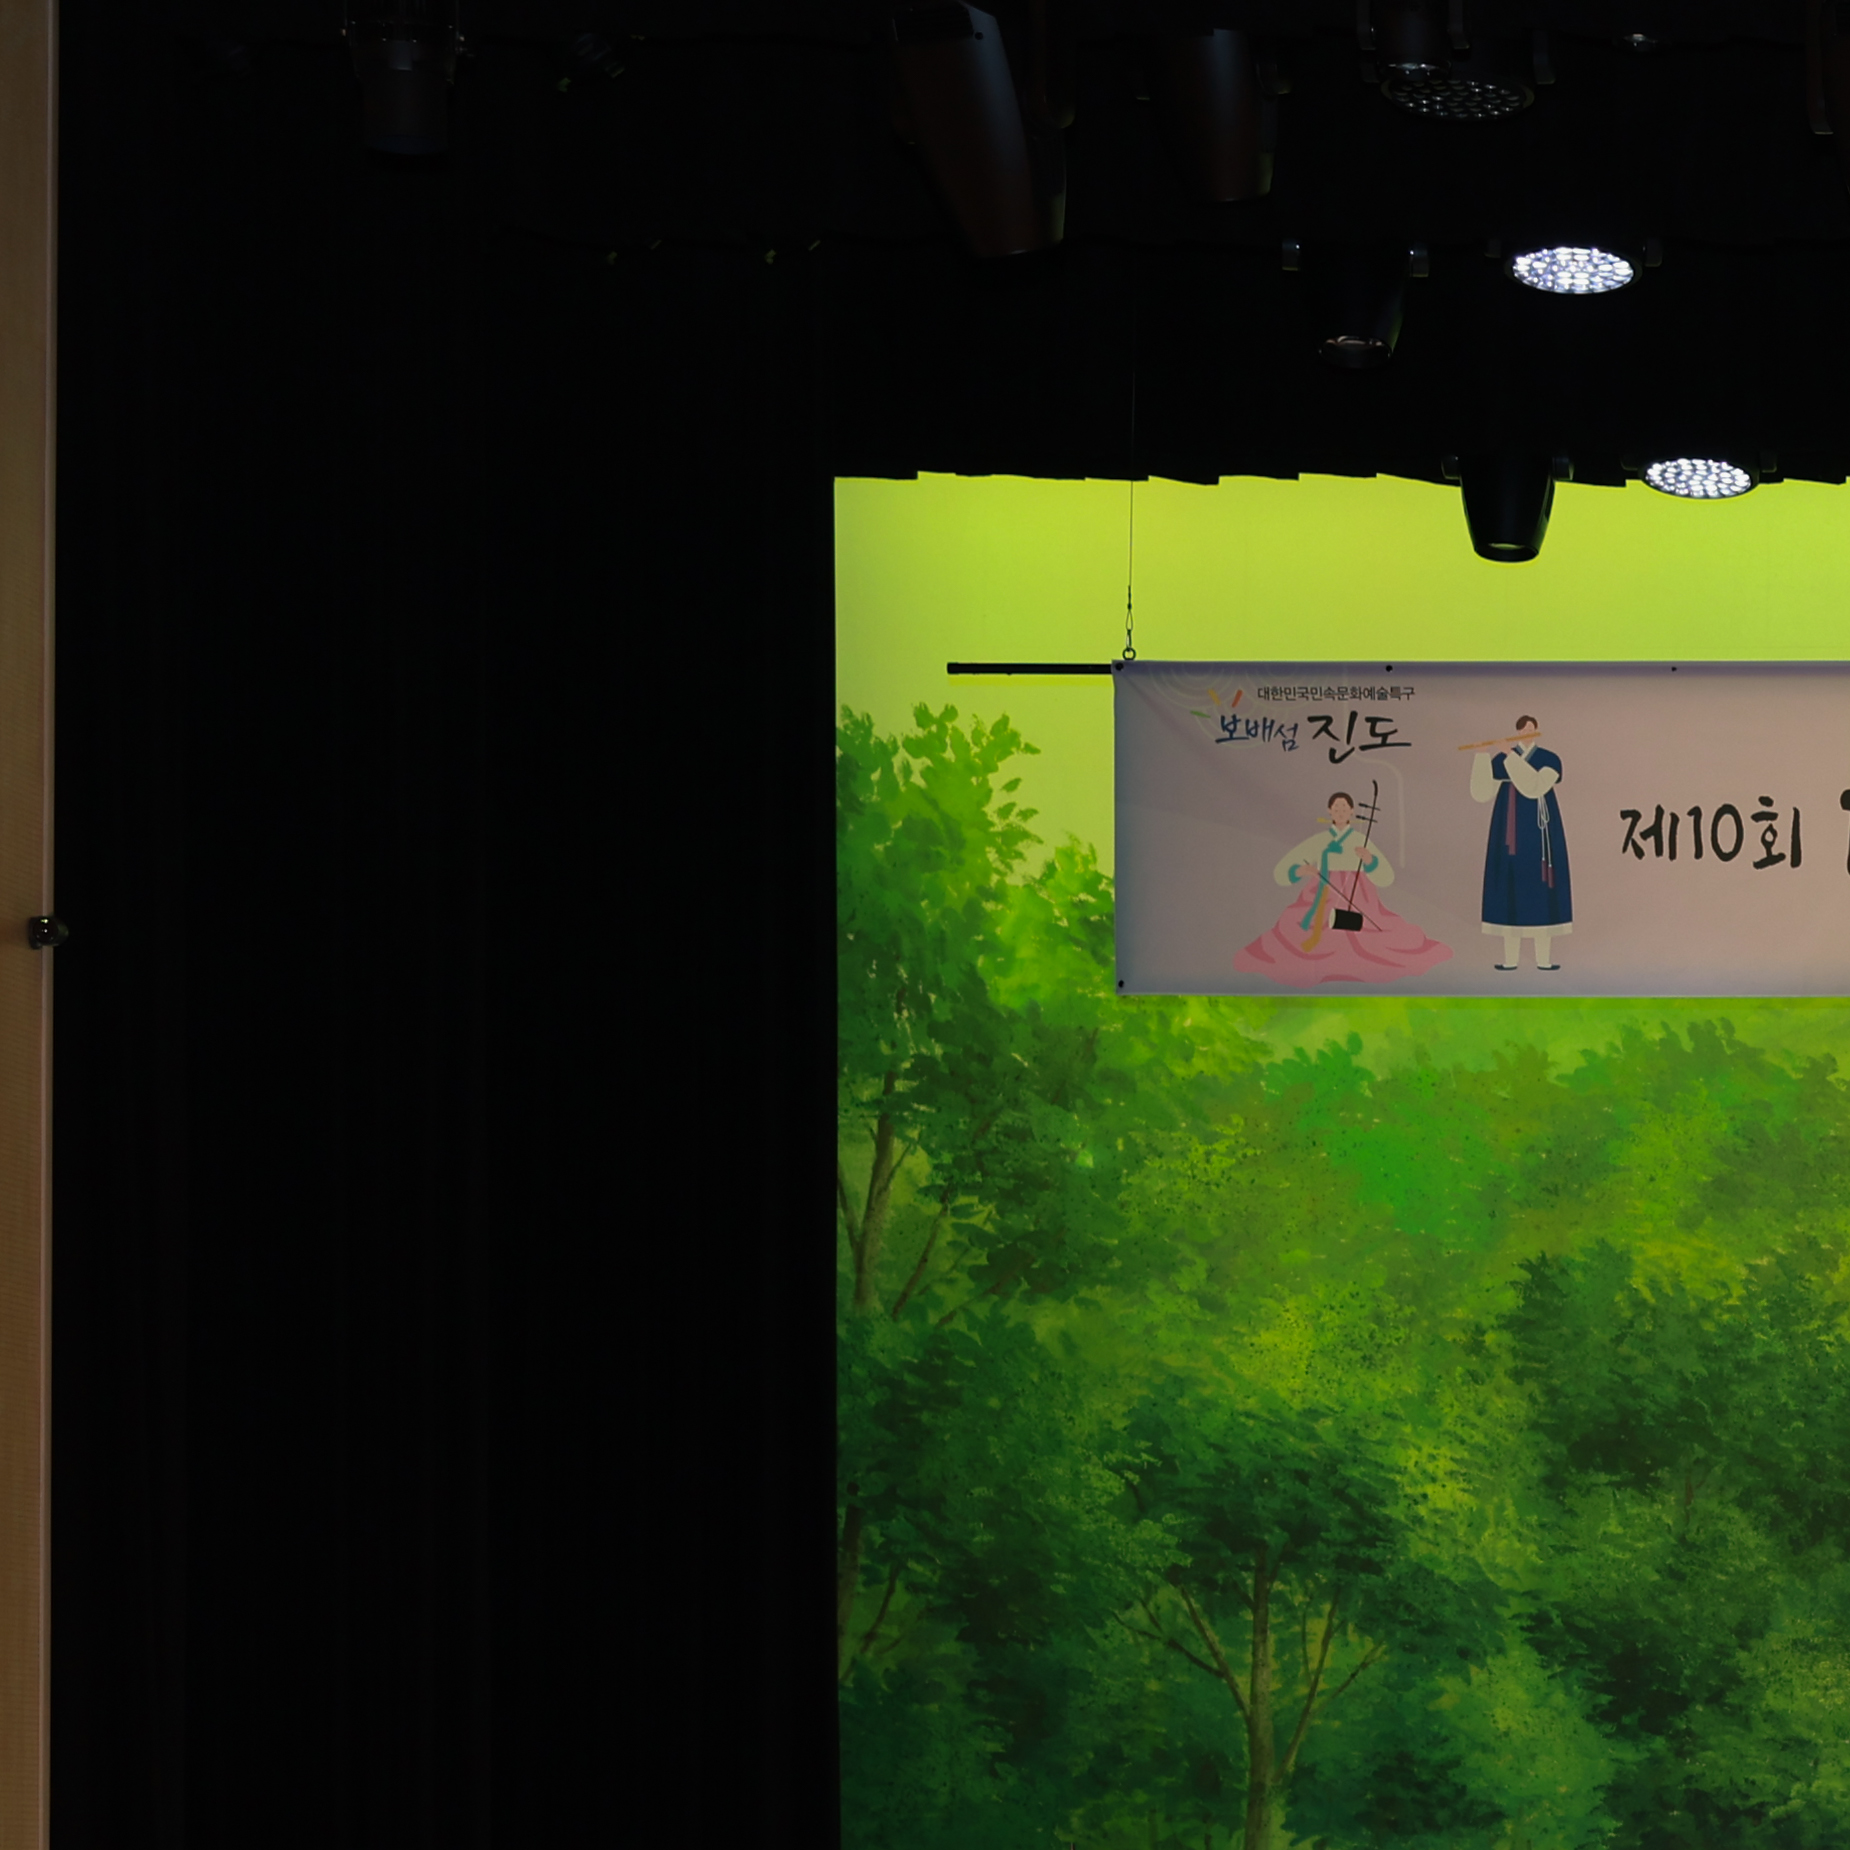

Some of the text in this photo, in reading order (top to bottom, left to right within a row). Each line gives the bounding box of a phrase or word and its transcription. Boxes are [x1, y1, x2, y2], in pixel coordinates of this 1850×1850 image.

[1258, 686, 1415, 700] 대한민국민속문화예술특구
[1215, 710, 1412, 764] 보배섬 진도
[1621, 797, 1801, 870] 제10회
